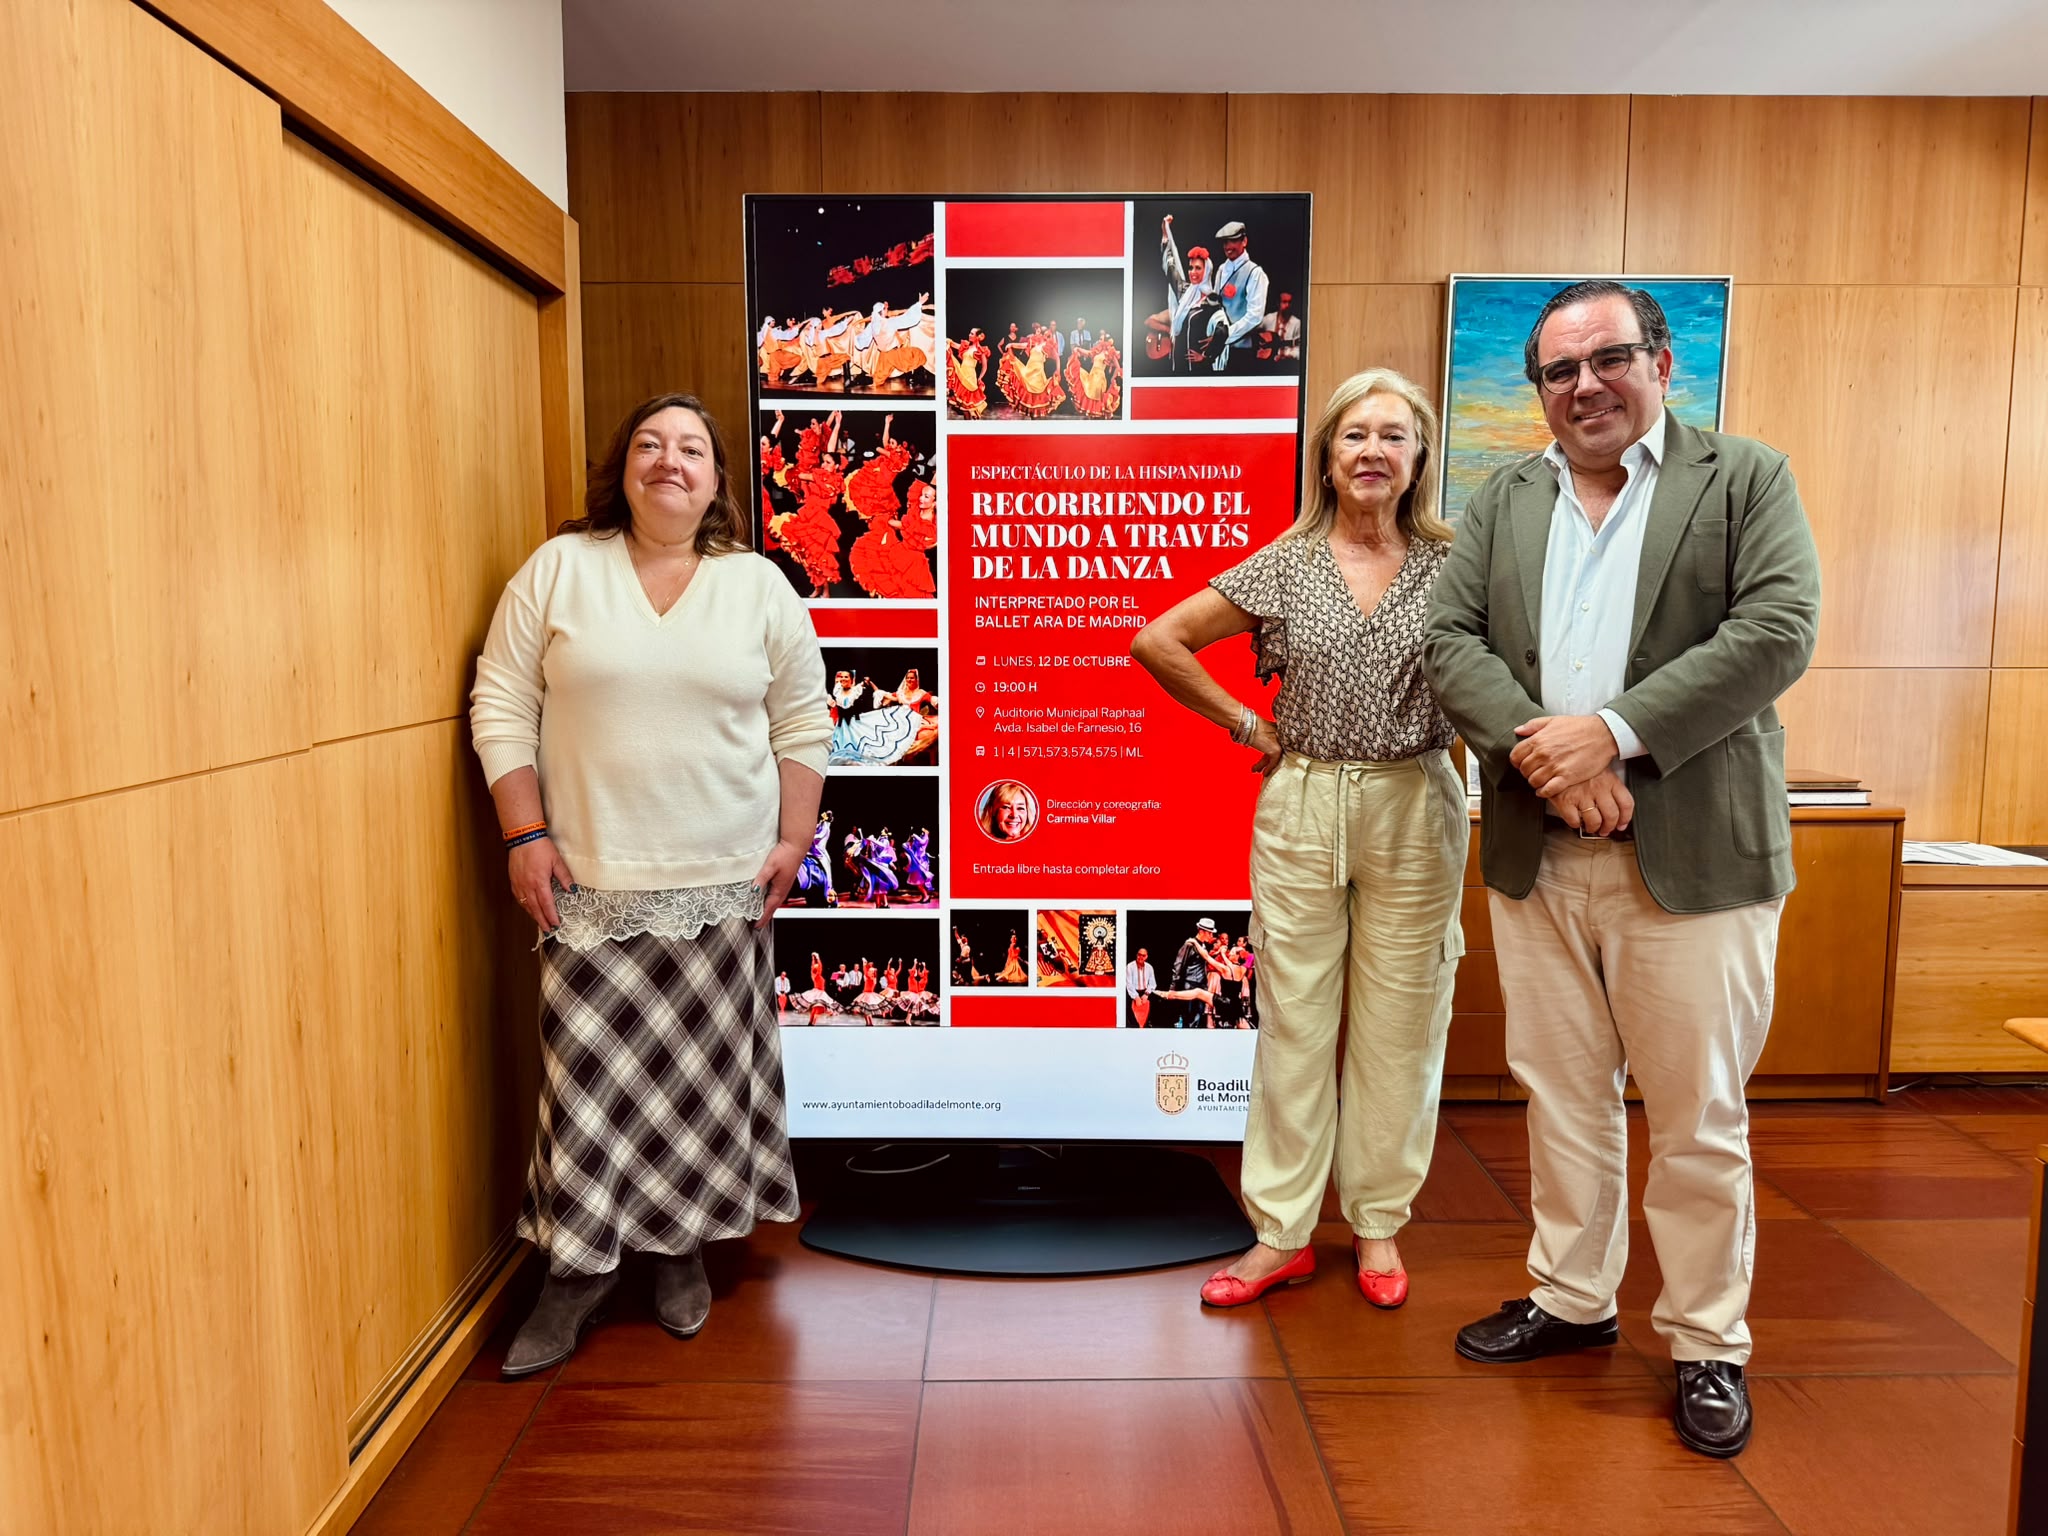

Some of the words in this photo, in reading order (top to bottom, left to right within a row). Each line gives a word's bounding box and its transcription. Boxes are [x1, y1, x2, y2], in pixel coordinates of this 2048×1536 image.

[971, 462, 1086, 480] ESPECTÁCULO
[1089, 465, 1111, 480] DE
[1115, 465, 1135, 480] LA
[1139, 464, 1242, 480] HISPANIDAD
[971, 491, 1206, 517] RECORRIENDO
[1212, 491, 1251, 516] EL
[970, 523, 1091, 548] MUNDO
[1096, 523, 1119, 548] A
[1125, 517, 1249, 549] TRAVÉS
[971, 555, 1014, 580] DE
[1020, 555, 1060, 580] LA
[1067, 555, 1175, 580] DANZA
[974, 595, 1086, 609] INTERPRETADO
[1088, 595, 1119, 609] POR
[1122, 595, 1140, 609] EL
[975, 615, 1030, 628] BALLET
[1033, 615, 1064, 628] ARA
[1067, 615, 1086, 628] DE
[1089, 615, 1147, 628] MADRID
[993, 655, 1036, 668] LUNES,
[1038, 655, 1051, 667] 12
[1053, 655, 1070, 667] DE
[1072, 655, 1131, 667] OCTUBRE
[993, 681, 1026, 693] 19:00
[1028, 681, 1037, 693] H
[993, 707, 1044, 718] Auditorio
[1046, 707, 1099, 720] Municipal
[993, 722, 1024, 733] Avda.
[1026, 722, 1059, 733] Isabel
[1061, 722, 1075, 733] de
[1077, 721, 1127, 735] Farnesio,
[1129, 721, 1142, 733] 16
[993, 746, 999, 757] 1
[1007, 746, 1015, 757] 4
[1125, 746, 1144, 757] ML
[1046, 799, 1093, 809] Dirección
[1095, 802, 1101, 811] y
[1103, 799, 1162, 811] coreografía:
[1046, 813, 1089, 824] Carmina
[1091, 813, 1117, 824] Villar
[973, 863, 1015, 875] Entrada
[1017, 863, 1041, 875] libre
[1042, 863, 1073, 875] hasta
[1075, 864, 1130, 876] completar
[1132, 863, 1161, 875] aforo
[1197, 1078, 1251, 1092] Boadill
[1197, 1093, 1215, 1103] del
[1217, 1092, 1250, 1103] Mont
[1196, 1104, 1248, 1112] AYUNTAMIEN
